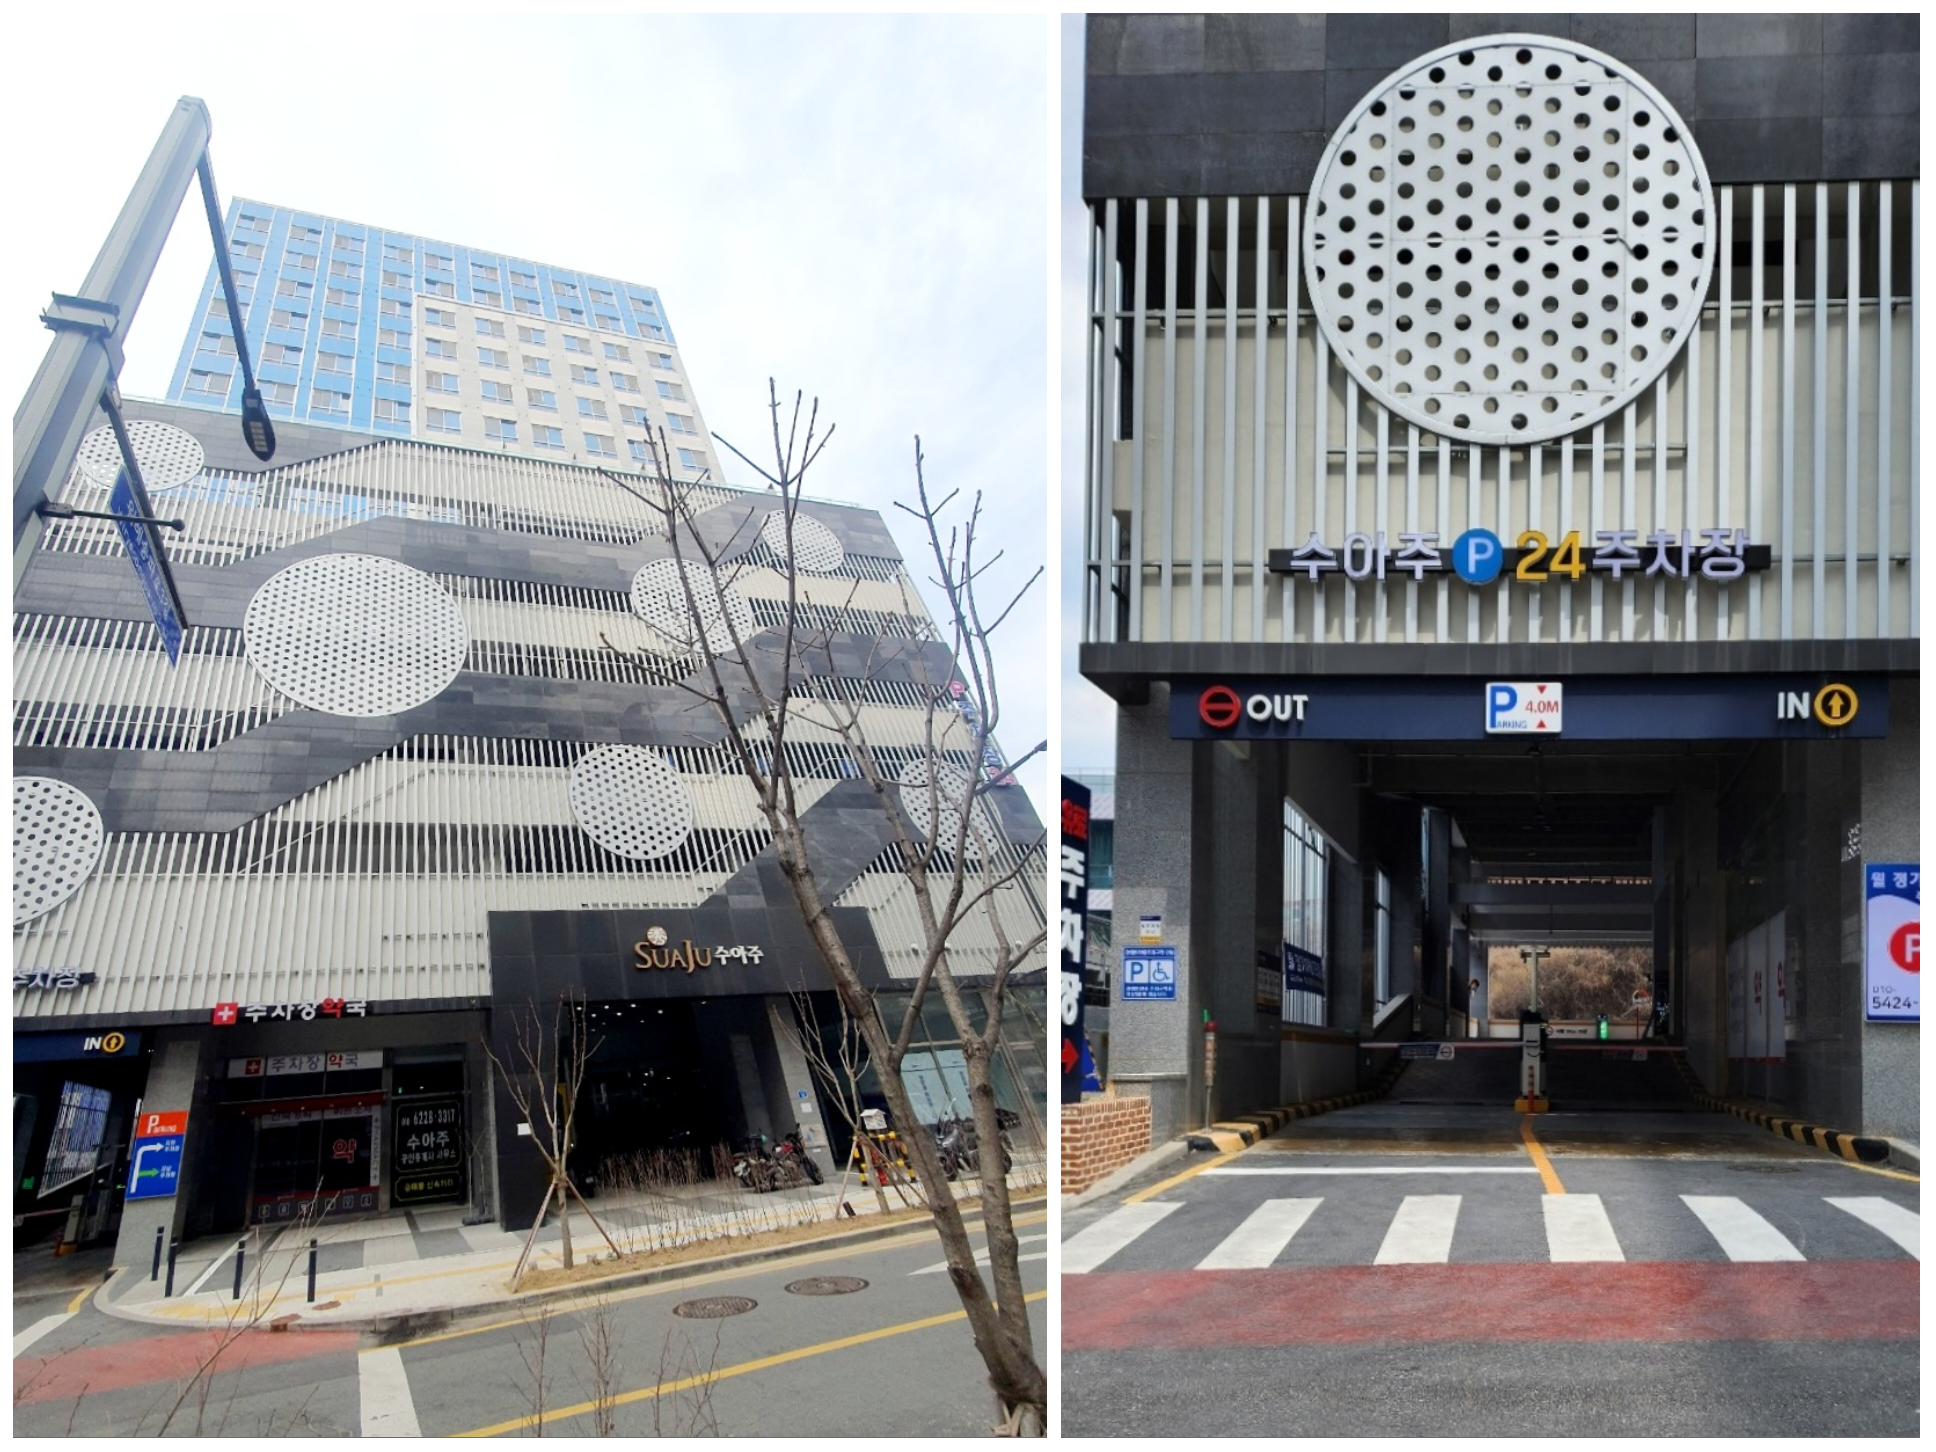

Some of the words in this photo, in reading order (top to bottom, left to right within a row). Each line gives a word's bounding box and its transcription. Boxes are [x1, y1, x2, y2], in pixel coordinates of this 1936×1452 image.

[1290, 531, 1442, 581] 수아주
[1516, 530, 1586, 582] 24
[1592, 528, 1750, 580] 주차장
[1246, 694, 1309, 721] OUT
[1525, 699, 1560, 714] 4.0M
[1777, 691, 1811, 720] IN
[713, 945, 765, 966] 수아주
[1130, 961, 1144, 982] P
[84, 1035, 101, 1050] IN
[333, 1138, 357, 1164] 약
[407, 1130, 450, 1151] 수아주
[436, 1149, 457, 1160] 사무소
